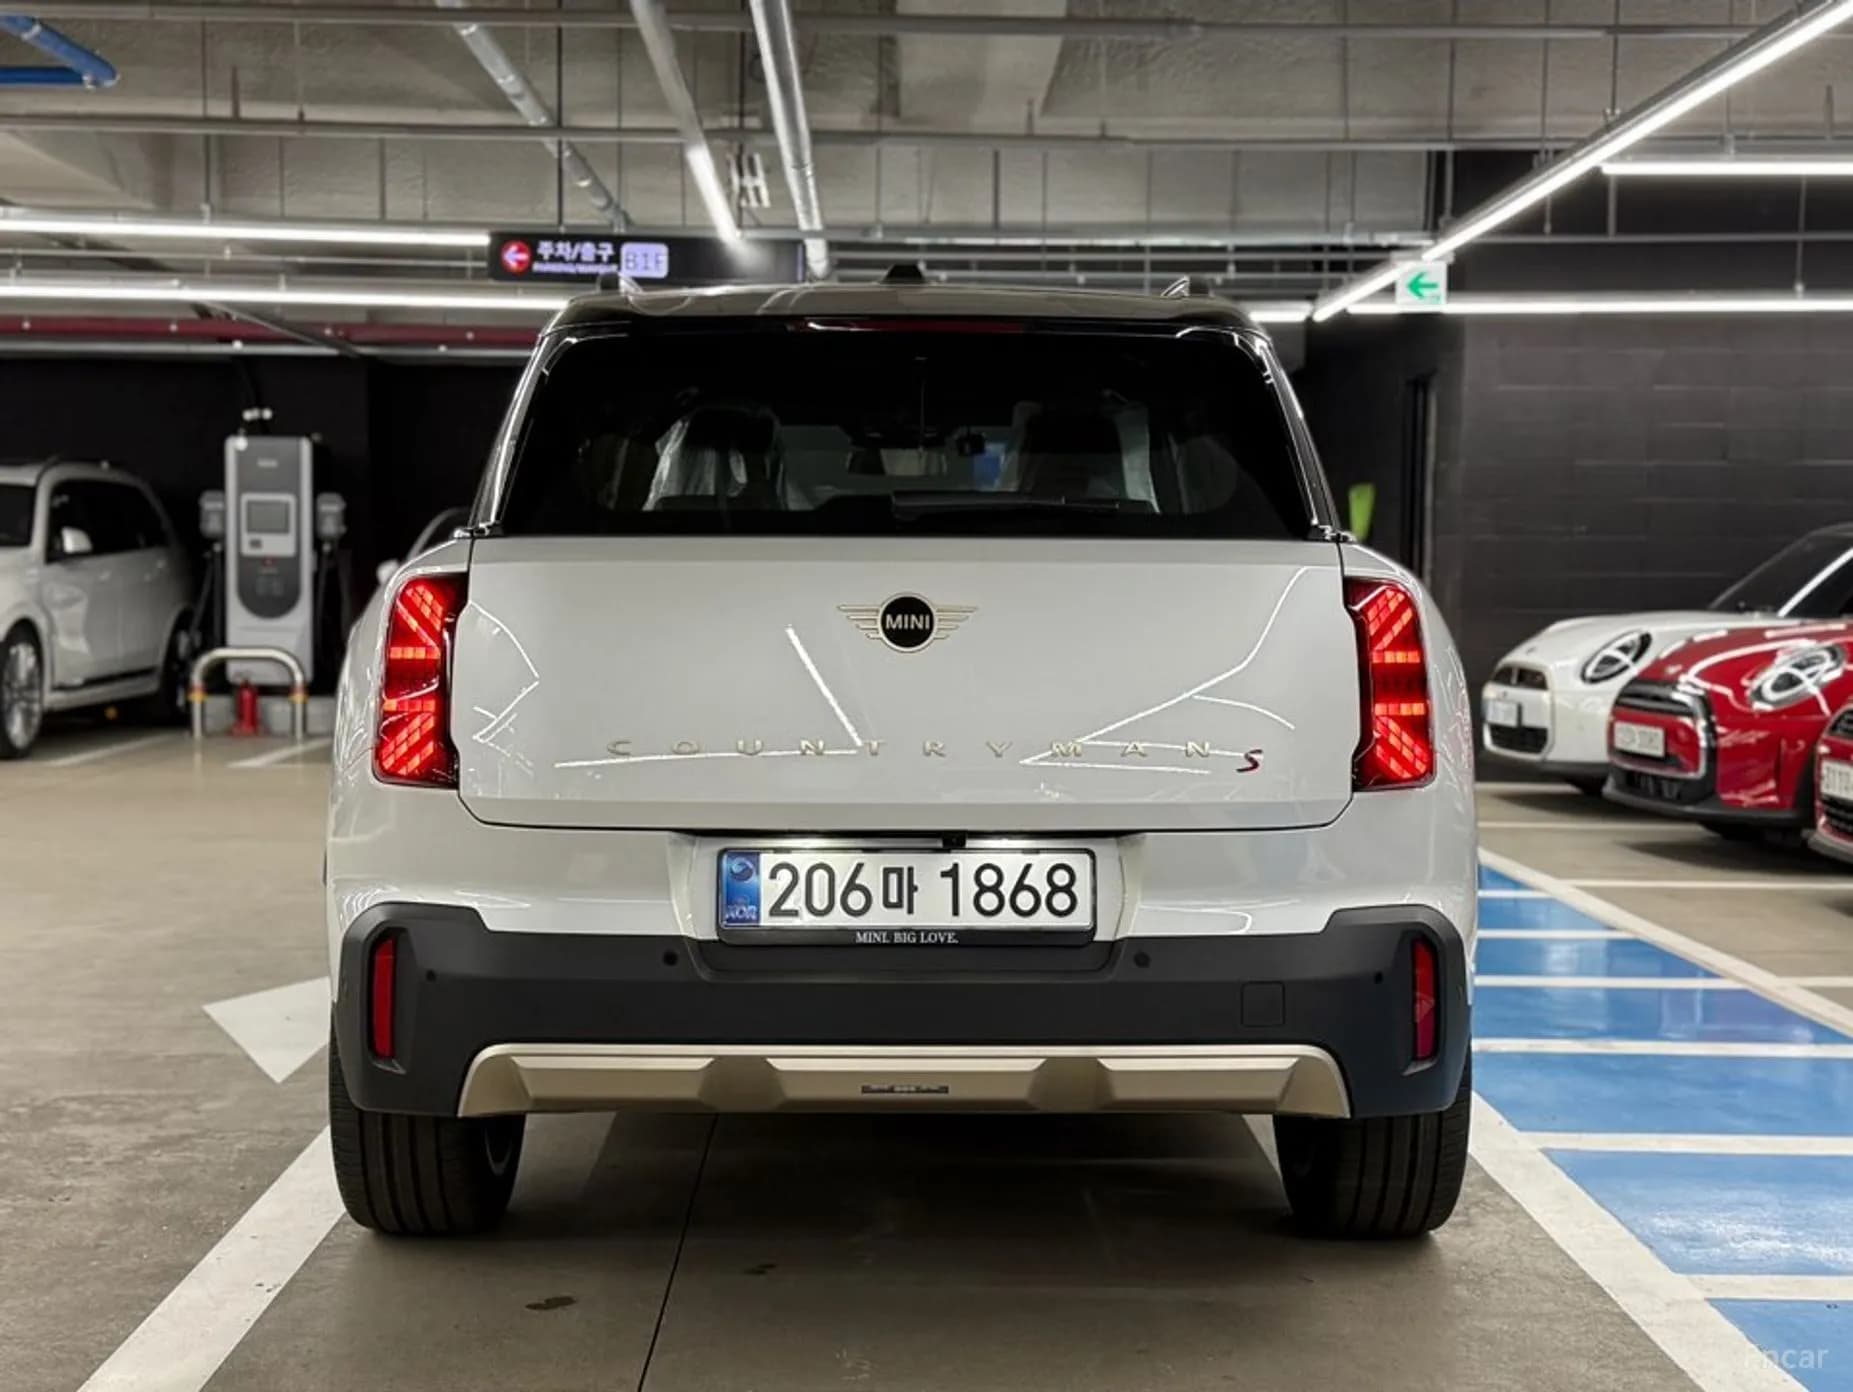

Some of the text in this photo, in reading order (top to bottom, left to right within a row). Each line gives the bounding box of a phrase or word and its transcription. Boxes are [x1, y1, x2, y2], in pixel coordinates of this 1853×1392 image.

[885, 613, 931, 630] MINI
[606, 737, 1210, 758] COUNTRYMAN
[1235, 748, 1263, 773] S
[768, 862, 1079, 918] 206마 1868
[894, 931, 917, 944] BIG
